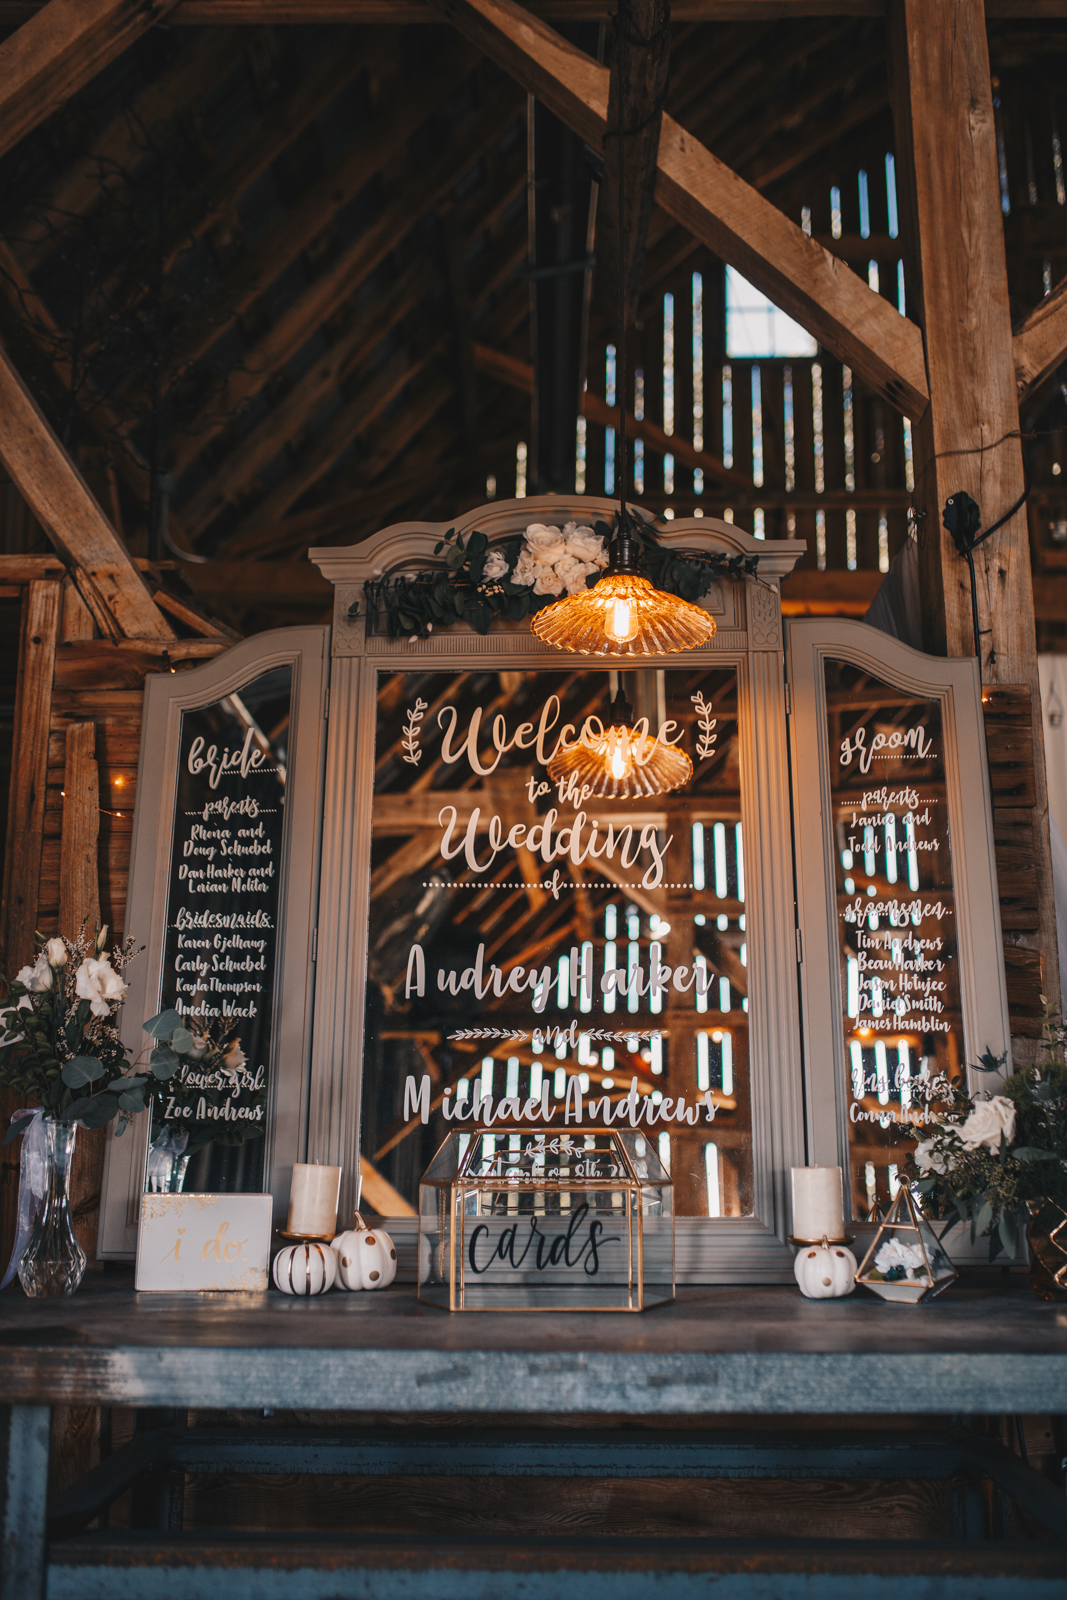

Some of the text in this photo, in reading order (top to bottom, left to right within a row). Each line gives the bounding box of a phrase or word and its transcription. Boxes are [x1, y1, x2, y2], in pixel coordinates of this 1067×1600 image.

[437, 695, 685, 776] Welcome
[188, 728, 266, 789] bride
[840, 725, 933, 774] groom
[525, 770, 593, 809] to the
[861, 786, 919, 811] parents
[203, 795, 260, 821] parents
[850, 808, 931, 828] Janice and
[191, 821, 266, 840] Rhona and
[183, 840, 217, 861] Doug
[438, 806, 673, 889] Wedding
[848, 835, 940, 853] Todd Andrews
[179, 861, 275, 880] Dan Harker and
[231, 877, 269, 893] Molitor
[544, 869, 565, 900] of
[176, 907, 271, 930] bridesmaids
[845, 897, 947, 928] groomsmen
[178, 934, 211, 949] Karen
[855, 930, 944, 951] Tim Andrews
[174, 954, 210, 976] Carly
[858, 951, 945, 973] Beau Harker
[176, 977, 262, 996] Kayla Thompson
[405, 943, 714, 1012] Audrey Harker
[857, 973, 897, 991] Jason
[175, 997, 257, 1018] Amelia Wack
[858, 993, 944, 1013] Daniel Smith
[532, 1019, 580, 1049] and
[853, 1013, 951, 1032] James Hamblin
[179, 1064, 226, 1091] lower
[852, 1068, 890, 1100] ring
[164, 1097, 264, 1121] Zoe Andrews
[403, 1075, 720, 1127] Michael Andrews
[849, 1102, 899, 1123] Connor
[160, 1221, 249, 1264] i do
[468, 1203, 621, 1276] cards
